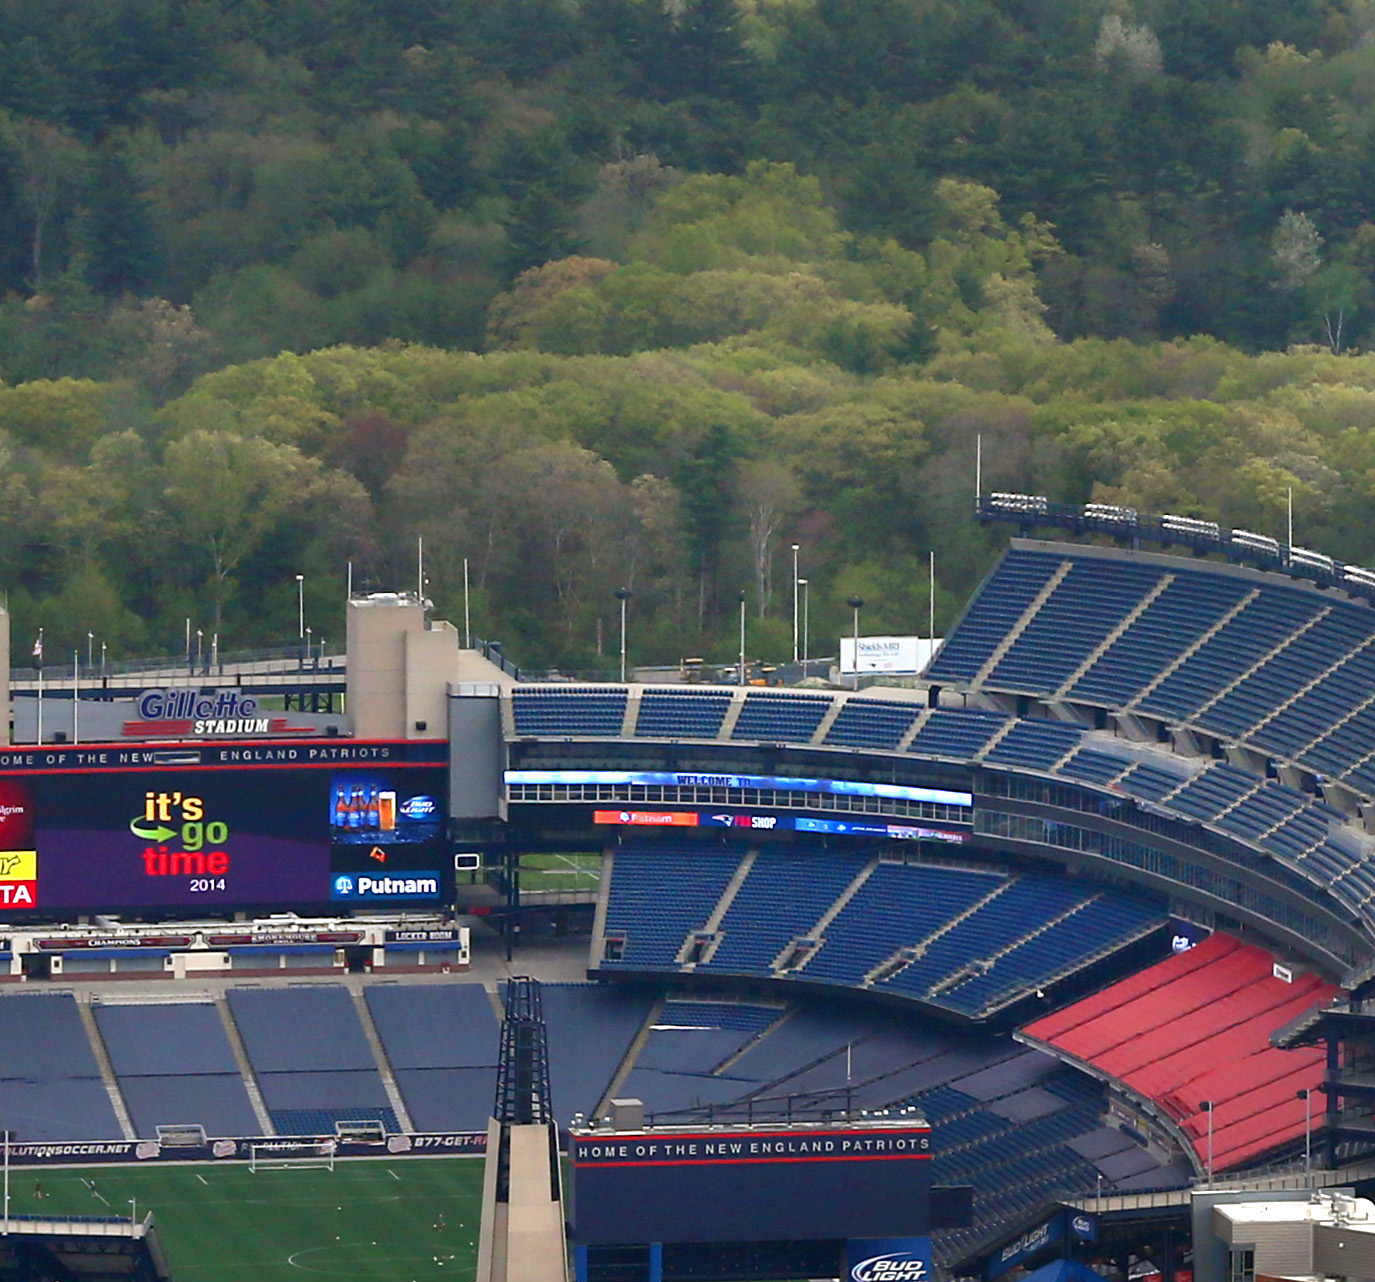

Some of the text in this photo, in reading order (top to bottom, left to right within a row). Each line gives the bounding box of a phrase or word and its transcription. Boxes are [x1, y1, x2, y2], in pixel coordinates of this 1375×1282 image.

[140, 689, 257, 719] Gillette
[194, 719, 269, 734] STADIUM
[46, 753, 66, 764] OF
[77, 753, 107, 764] THE
[119, 752, 155, 763] NEW
[220, 749, 298, 761] ENGLAND
[309, 747, 390, 760] PATRIOTS
[677, 775, 733, 787] WELCOME
[145, 792, 204, 821] it's
[631, 813, 672, 823] Putnam
[181, 821, 229, 851] go
[143, 847, 230, 876] time
[189, 879, 226, 891] 2014
[358, 877, 436, 895] Putnam
[87, 938, 141, 947] CHAMPIONS
[395, 930, 453, 941] LOCKER ROOM
[579, 1138, 930, 1158] HOME OF THE NEW ENGLAND PATRIOTS
[1001, 1242, 1021, 1262] BUD
[1024, 1222, 1050, 1247] LIGHT
[872, 1260, 923, 1271] BUD
[862, 1270, 927, 1282] LIGHT
